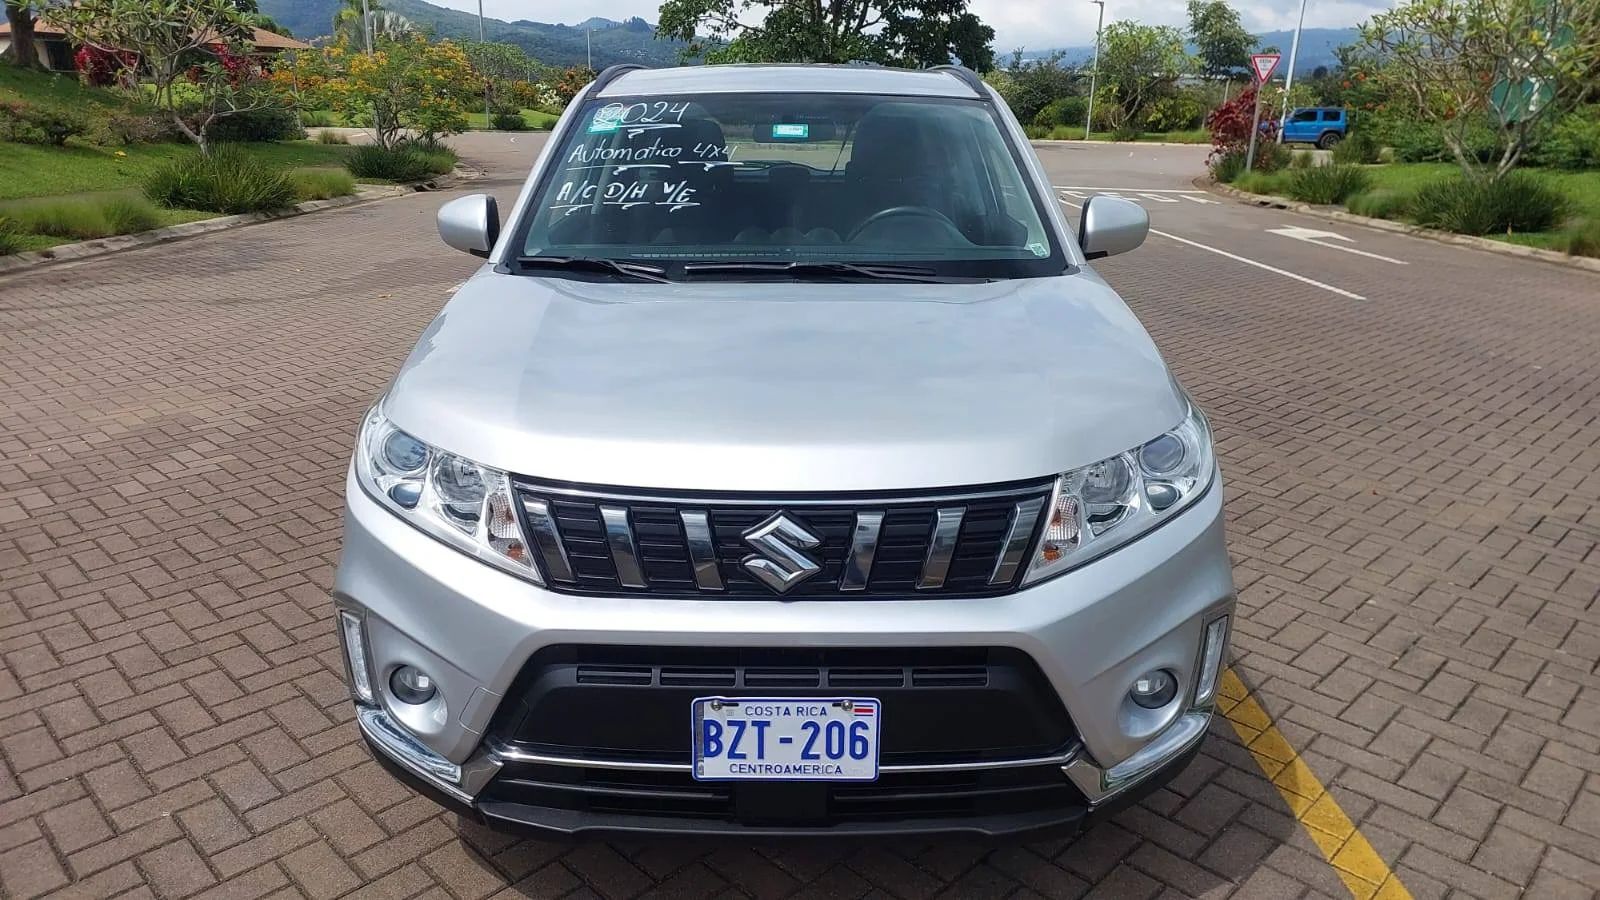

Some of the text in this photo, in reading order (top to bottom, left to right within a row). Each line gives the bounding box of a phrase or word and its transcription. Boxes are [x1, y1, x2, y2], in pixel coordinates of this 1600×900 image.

[593, 101, 690, 124] 2024
[568, 138, 682, 163] Automatico
[556, 180, 697, 203] A/C D/H V/E
[745, 706, 791, 717] COSTA
[796, 706, 827, 717] RICA
[703, 719, 869, 760] BZT-206
[729, 763, 843, 775] CENTROAMERICA
